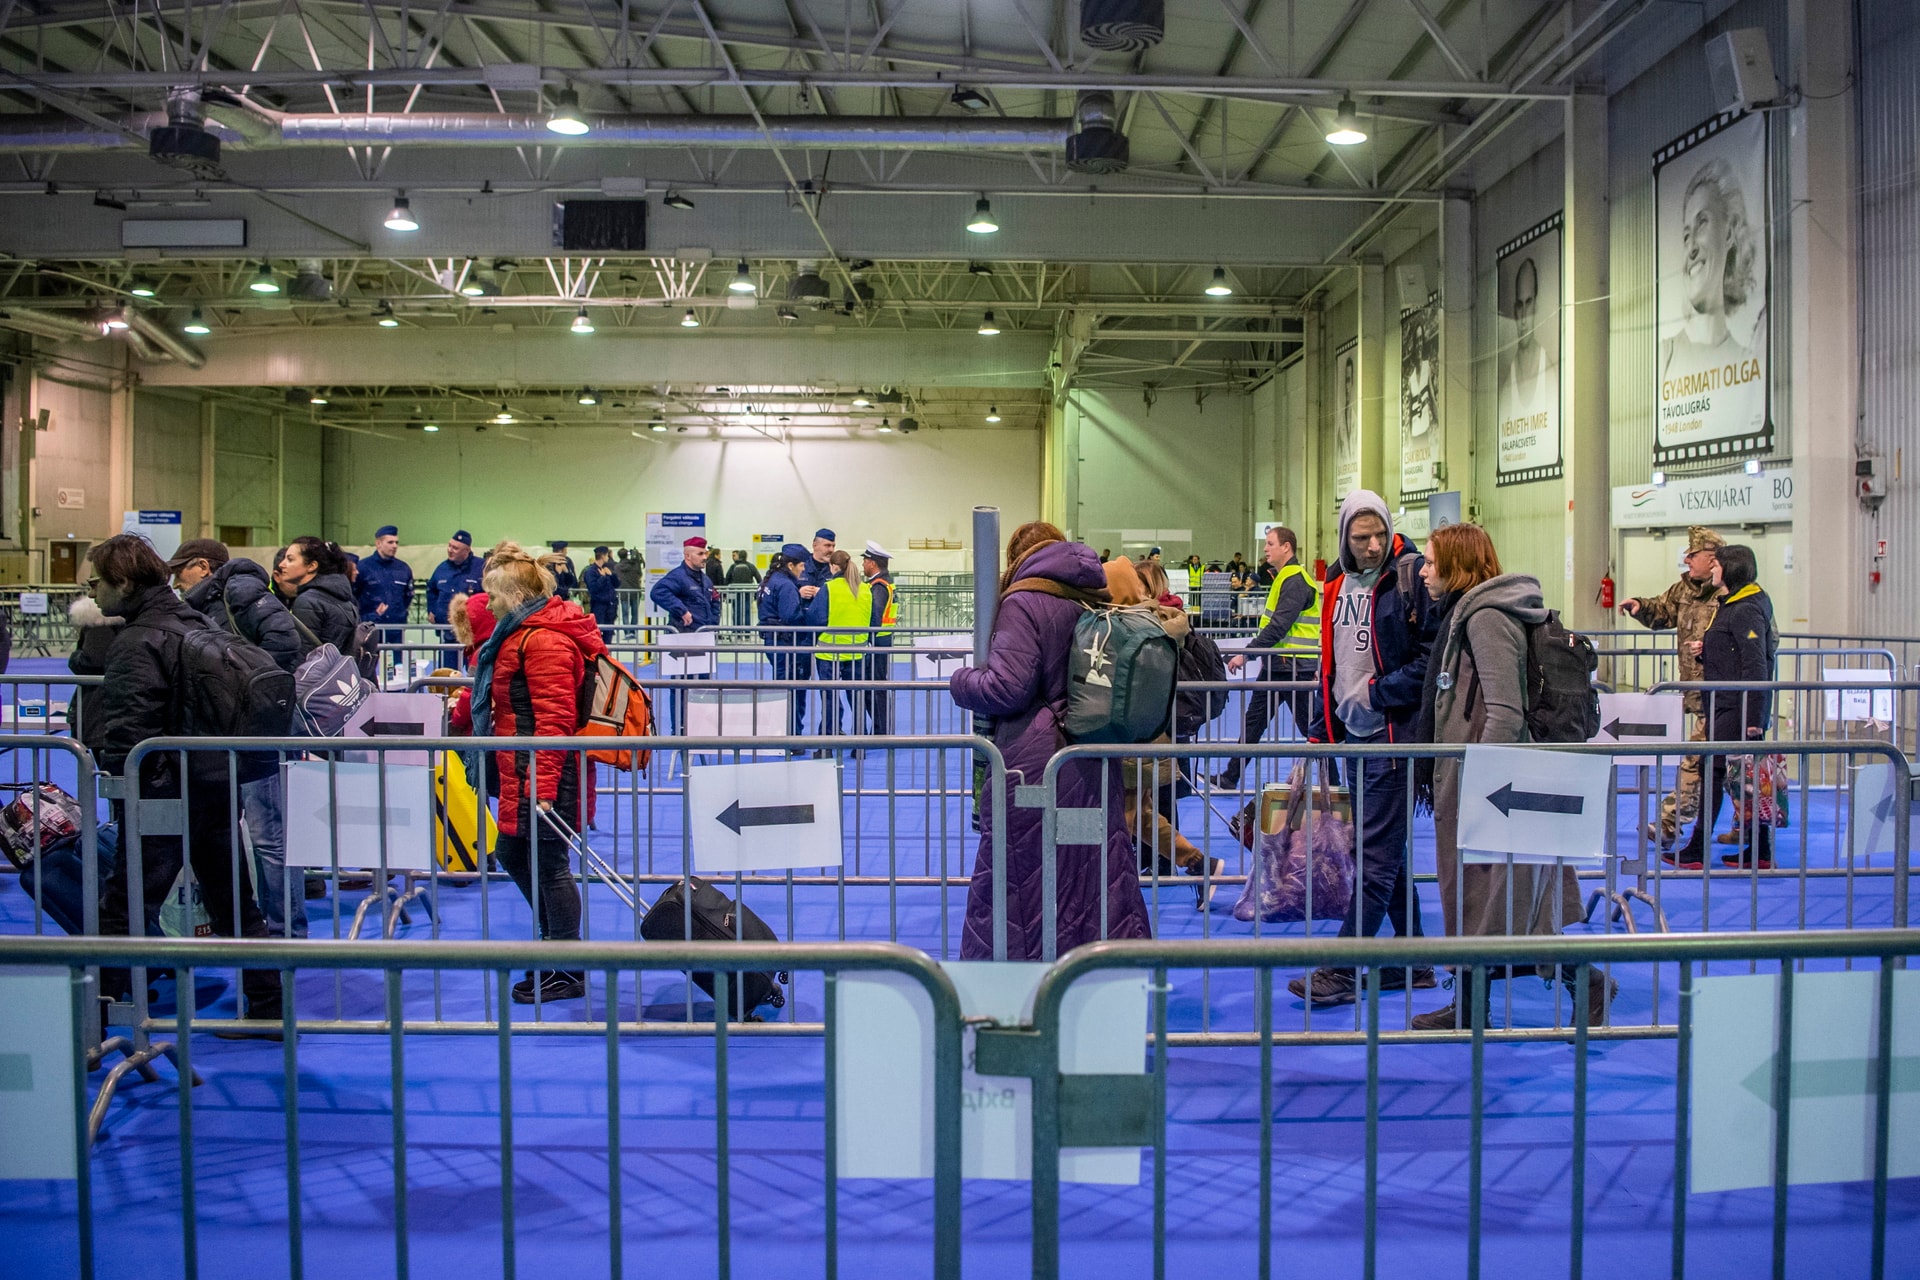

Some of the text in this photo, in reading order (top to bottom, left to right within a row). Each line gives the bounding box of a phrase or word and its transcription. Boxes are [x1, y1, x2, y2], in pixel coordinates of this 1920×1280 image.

[1662, 358, 1761, 401] GYARMATI OLGA
[1662, 395, 1710, 420] TÁVOLUGRÁS
[1502, 411, 1548, 438] NÉMETH IMRE
[1679, 419, 1702, 432] London
[1679, 485, 1753, 511] VÉSZKIJÁRAT
